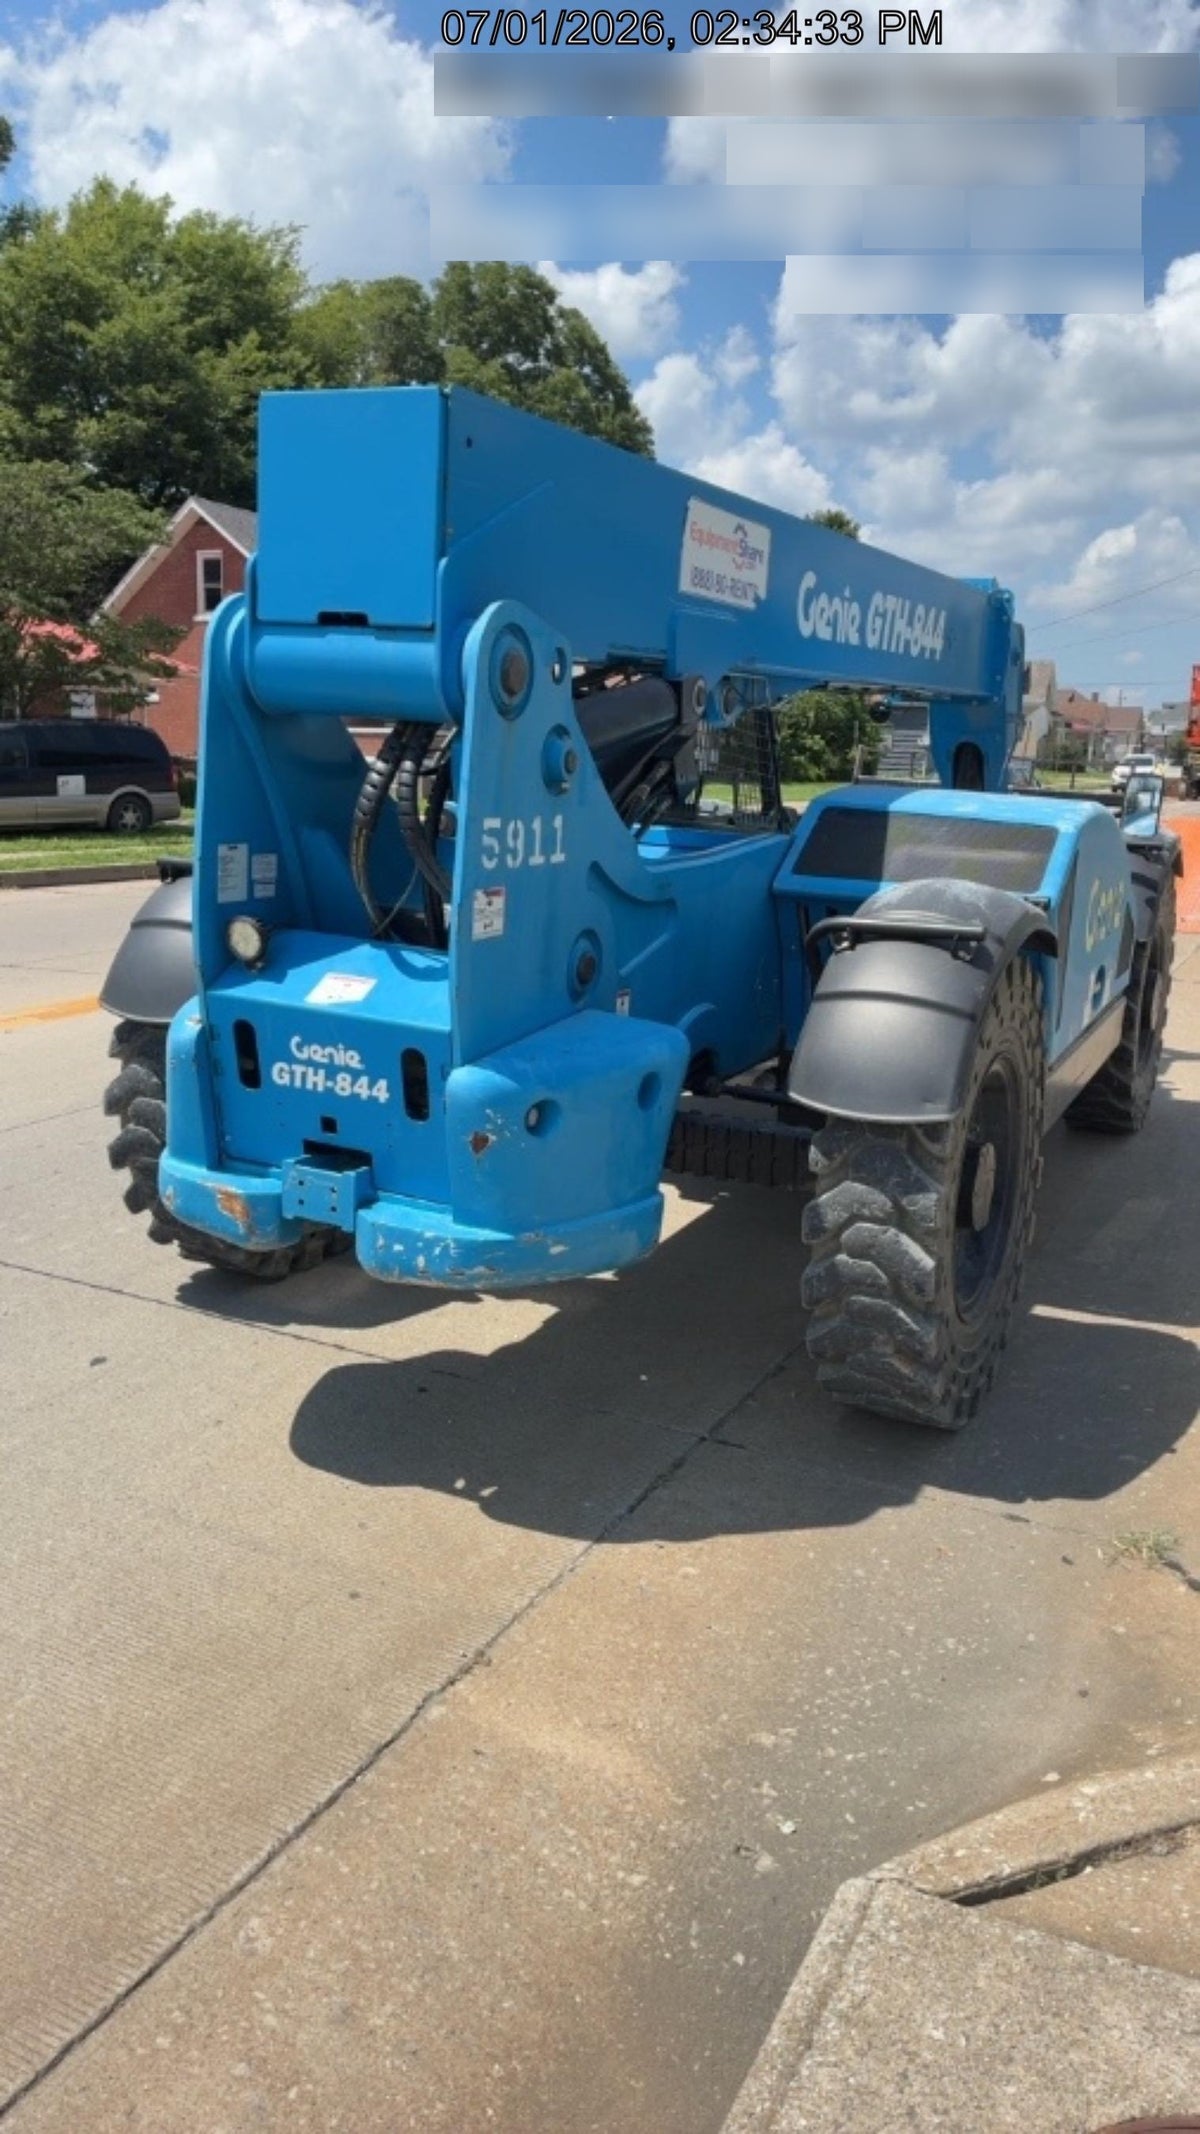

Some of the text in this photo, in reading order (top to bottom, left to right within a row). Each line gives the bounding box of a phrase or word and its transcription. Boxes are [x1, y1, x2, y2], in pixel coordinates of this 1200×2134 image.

[797, 570, 948, 662] Genie GTH-844
[481, 814, 566, 870] 5911
[289, 1035, 366, 1070] Genie
[271, 1061, 390, 1104] GTH-844
